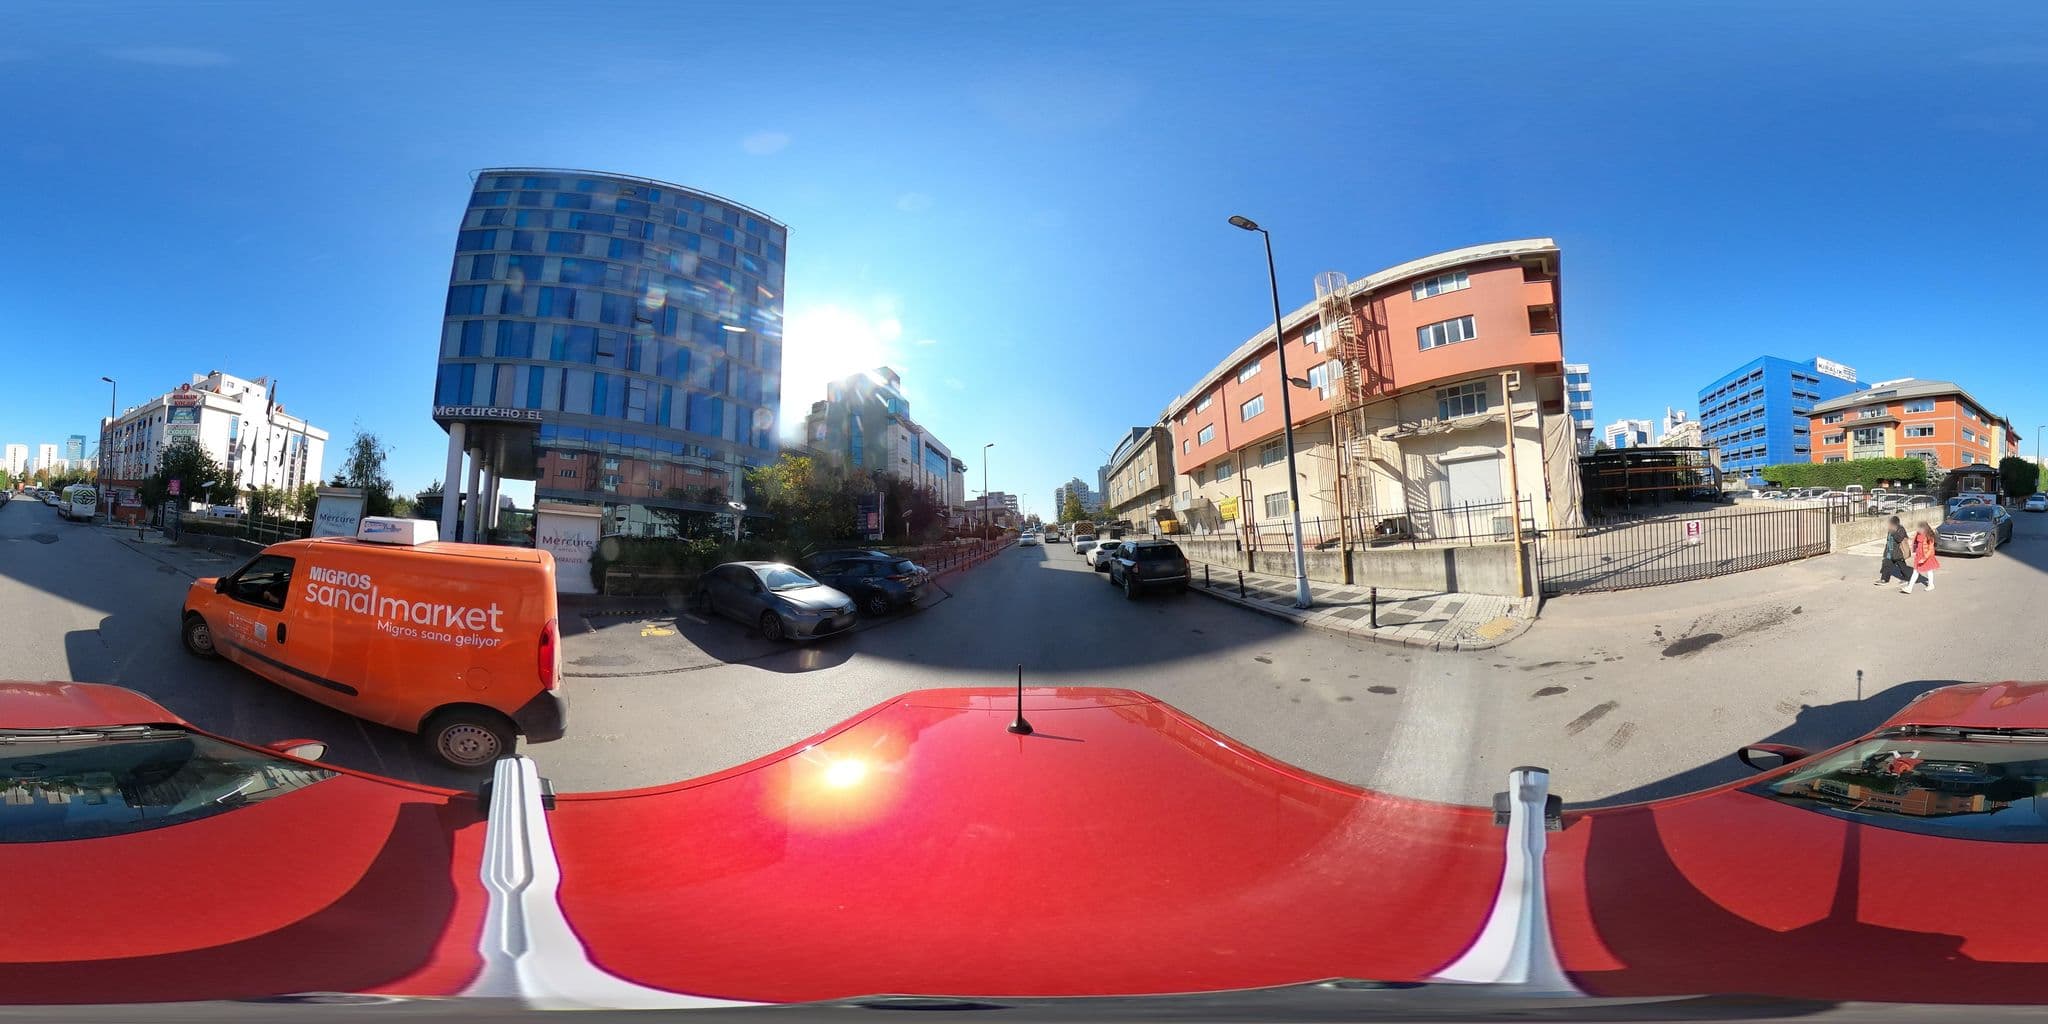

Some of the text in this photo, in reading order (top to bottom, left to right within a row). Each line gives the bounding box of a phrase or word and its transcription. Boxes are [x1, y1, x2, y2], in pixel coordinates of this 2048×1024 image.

[432, 405, 499, 418] Mercure
[320, 513, 356, 525] Mercure
[542, 535, 594, 548] Mercure
[377, 620, 501, 649] Migros sana geliyor
